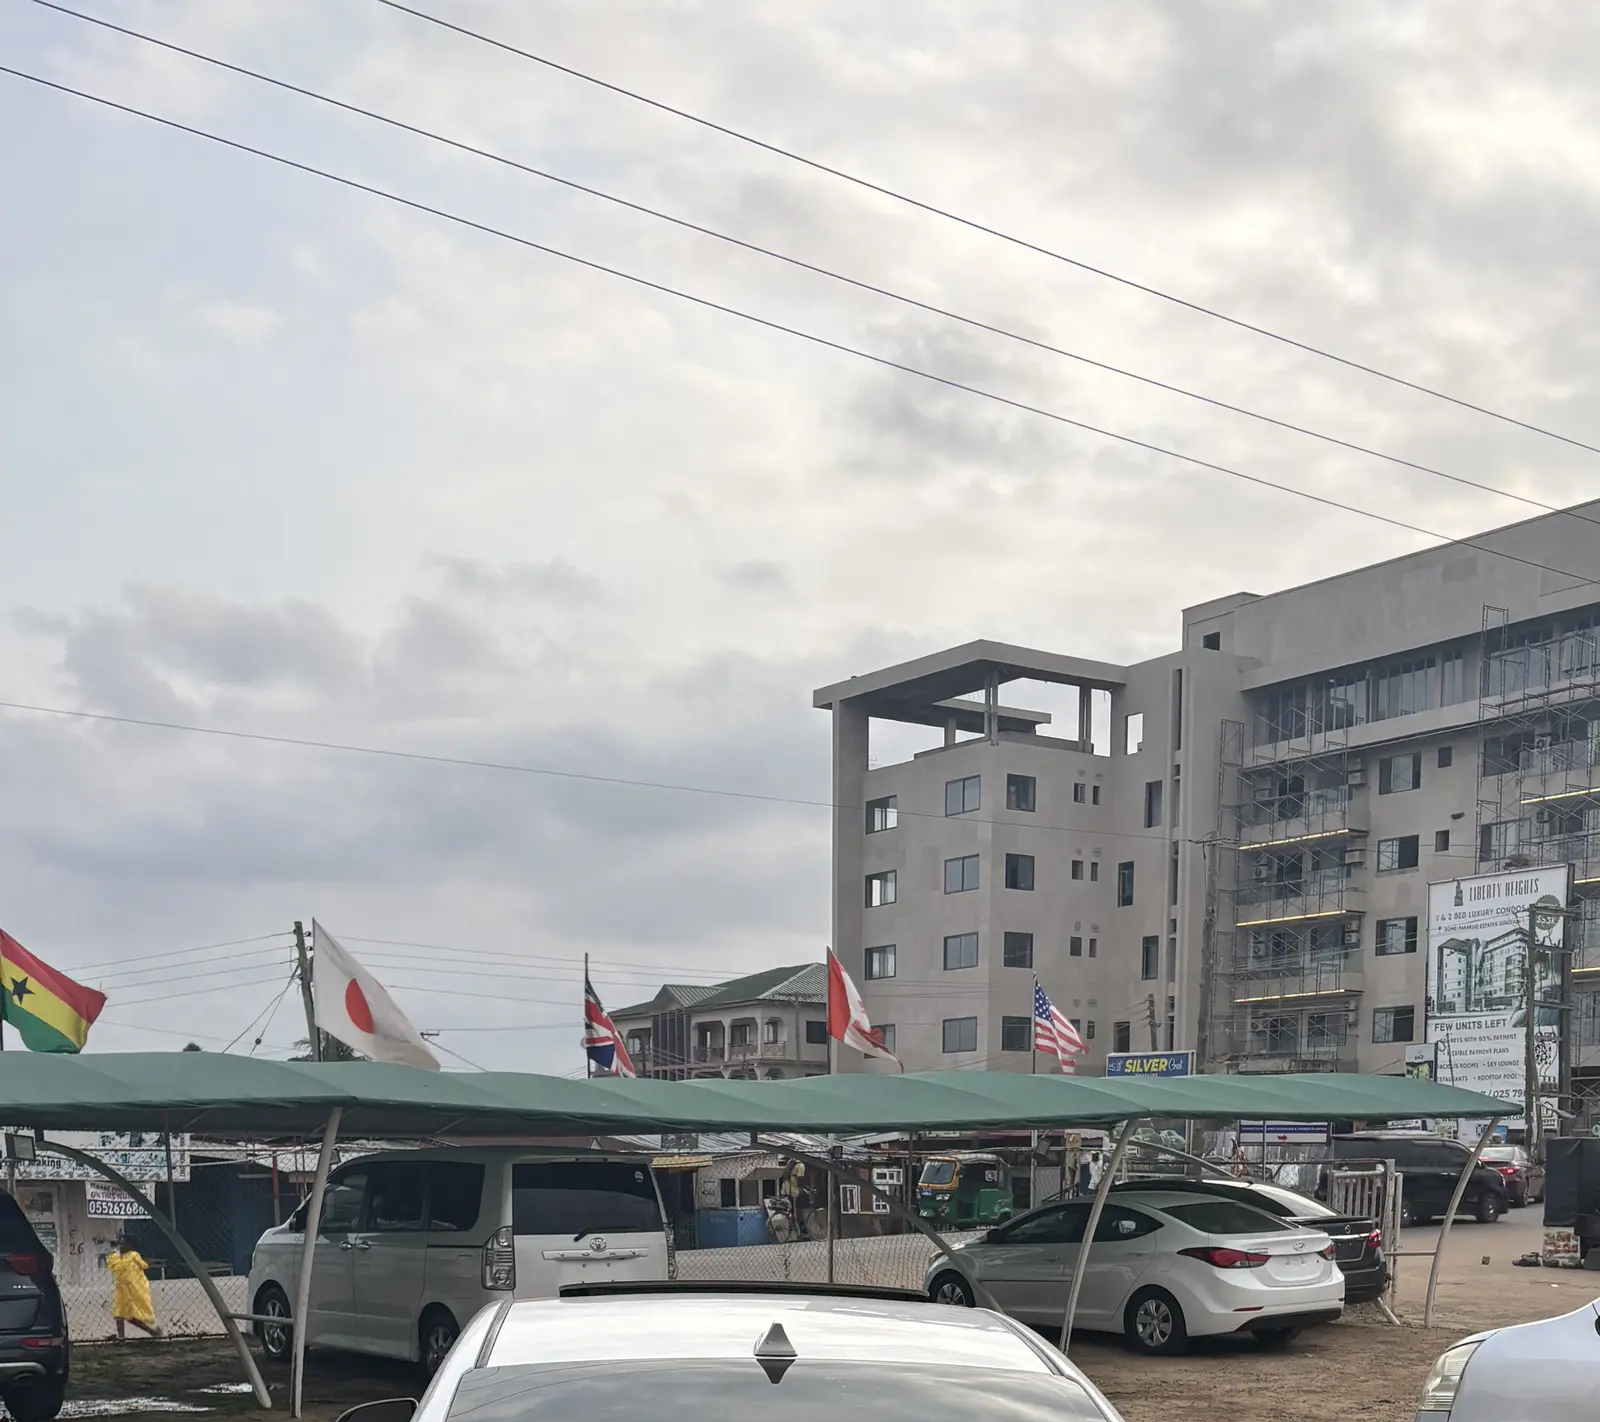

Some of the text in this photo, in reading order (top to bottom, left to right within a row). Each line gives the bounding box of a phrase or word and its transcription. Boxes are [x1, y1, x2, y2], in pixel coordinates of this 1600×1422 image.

[1469, 878, 1539, 901] LIBERTY HEIGHTS
[1454, 910, 1467, 919] BED
[1468, 907, 1494, 918] LUXURY
[1495, 904, 1526, 914] CONDOS
[1434, 1019, 1508, 1031] FEW UNITS LEFT
[1124, 1058, 1168, 1073] SILVER
[1498, 1059, 1519, 1067] LOUNGE
[1493, 1089, 1510, 1099] 025
